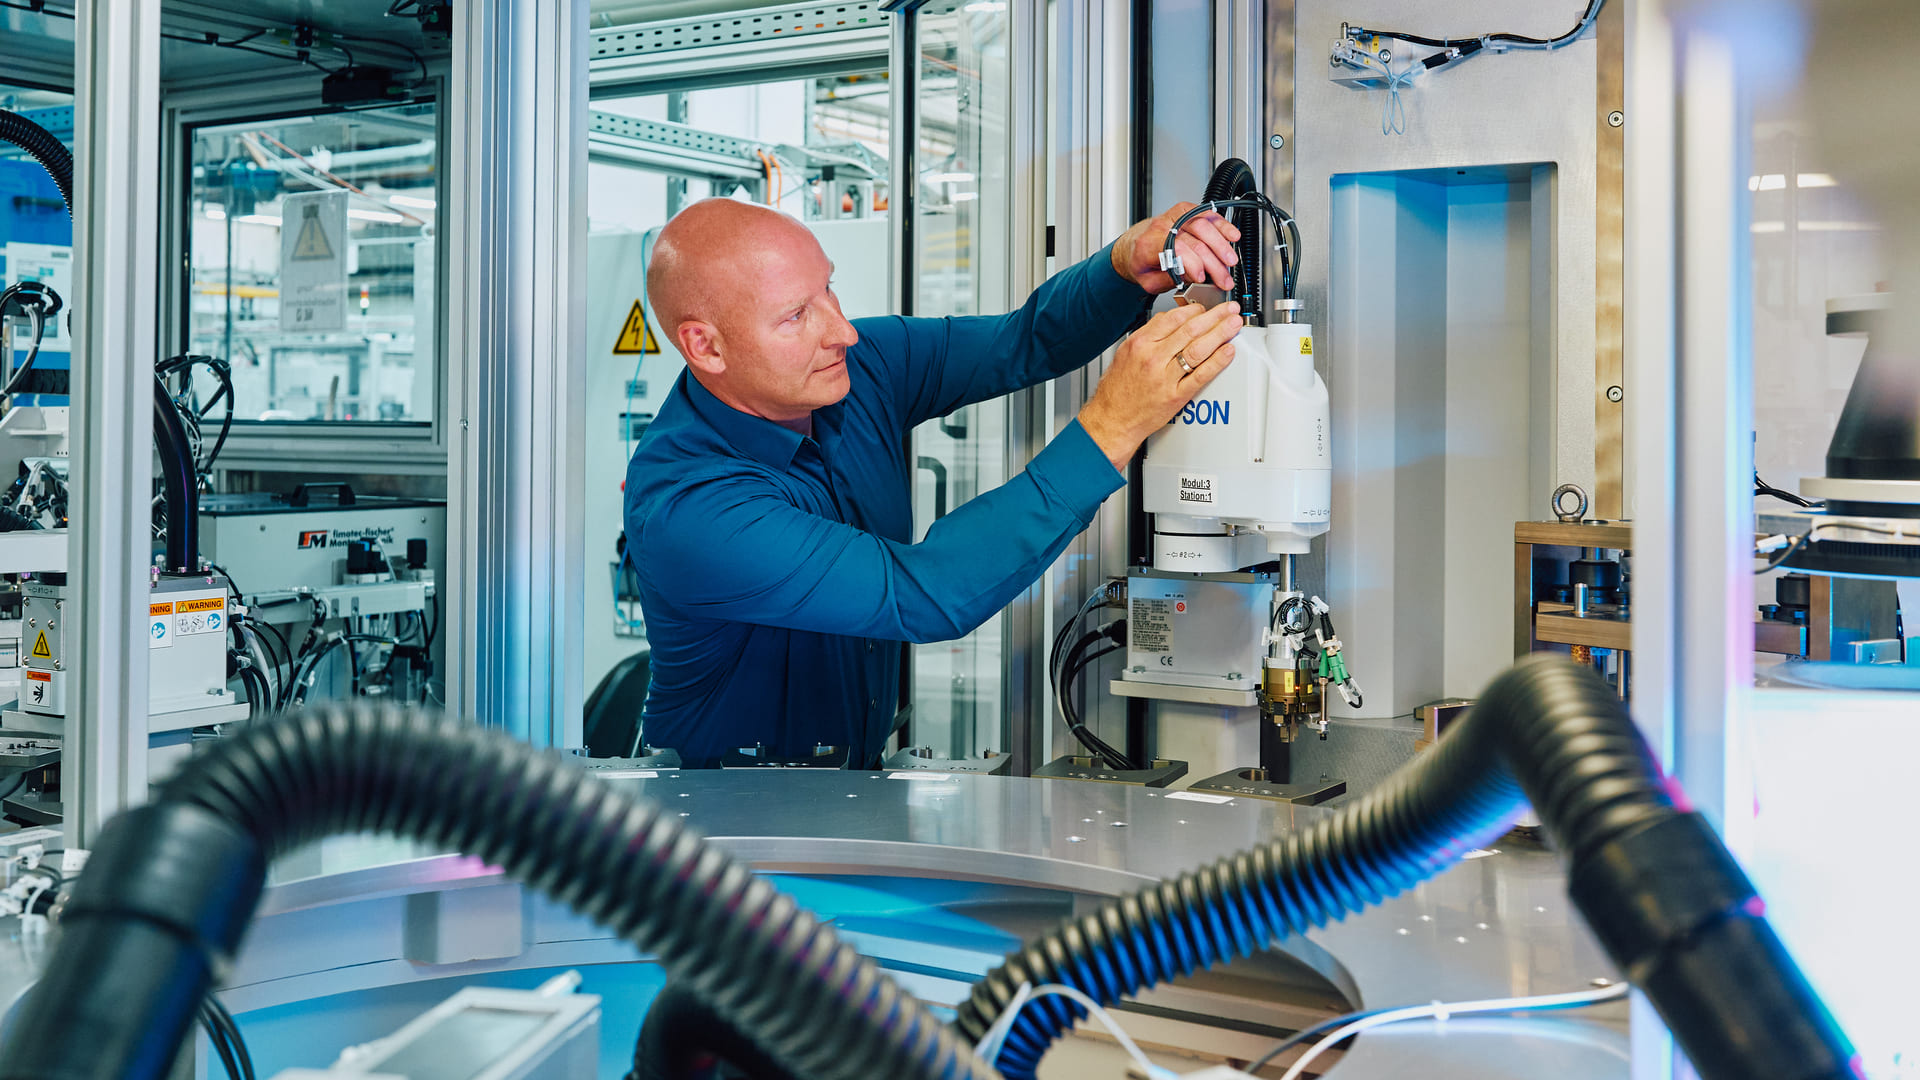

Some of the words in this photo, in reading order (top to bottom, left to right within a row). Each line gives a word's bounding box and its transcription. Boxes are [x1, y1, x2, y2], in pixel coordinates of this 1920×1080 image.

[1167, 399, 1230, 425] SON
[1181, 478, 1211, 490] Modul:3
[1180, 490, 1212, 502] Station:1
[188, 600, 222, 610] WARNING
